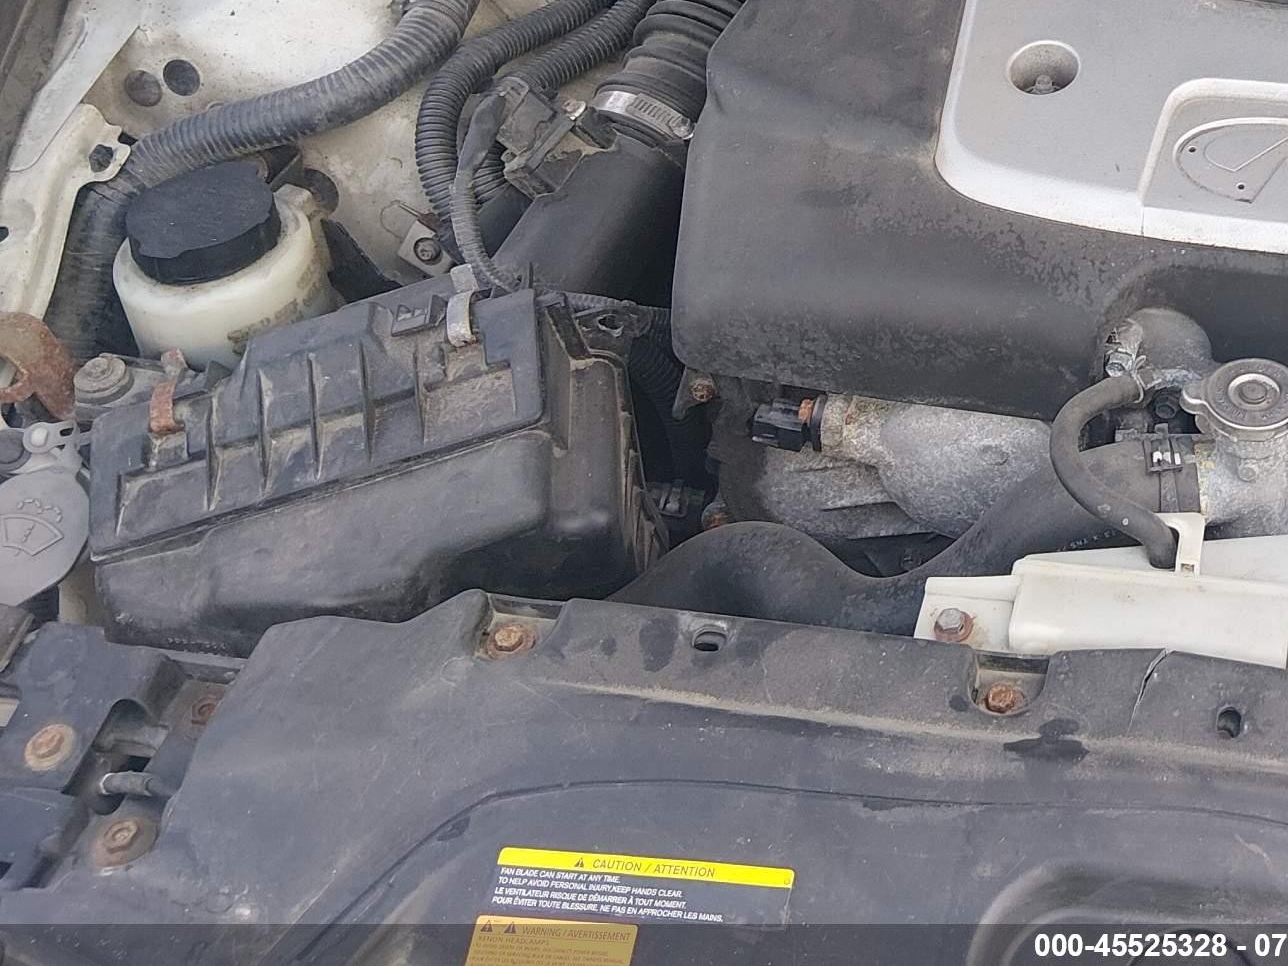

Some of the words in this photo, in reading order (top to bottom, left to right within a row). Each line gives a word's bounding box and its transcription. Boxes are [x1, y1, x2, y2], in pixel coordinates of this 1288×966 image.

[500, 867, 515, 876] FAN
[516, 868, 539, 877] BLADE
[540, 870, 555, 878] CAN
[556, 871, 577, 880] START
[588, 873, 603, 882] ANY
[592, 858, 643, 872] CAUTION
[653, 864, 716, 878] ATTENTION
[498, 876, 509, 884] TO
[509, 877, 527, 886] HELP
[527, 878, 549, 887] AVOID
[550, 880, 588, 891] PERSONAL
[632, 886, 658, 897] HANDS
[658, 889, 683, 898] CLEAR.
[494, 886, 504, 895] LE
[504, 887, 549, 898] VENTILATEUR
[550, 891, 576, 902] RISQUE
[577, 893, 588, 901] DE
[588, 892, 628, 904] DÉMARRER
[635, 898, 654, 907] TOUT
[654, 900, 687, 909] MOMENT.
[492, 896, 513, 905] POUR
[513, 895, 538, 907] ÉVITER
[538, 899, 561, 909] TOUTE
[599, 904, 610, 913] NE
[611, 905, 626, 914] PAS
[626, 907, 637, 915] EN
[637, 907, 683, 918] APPROCHER
[683, 912, 698, 920] LES
[698, 913, 724, 922] MAINS.
[478, 935, 503, 944] XENON
[505, 937, 549, 946] HEADLAMPS
[522, 926, 562, 938] WARNING
[569, 929, 631, 941] AVERTISSEMENT
